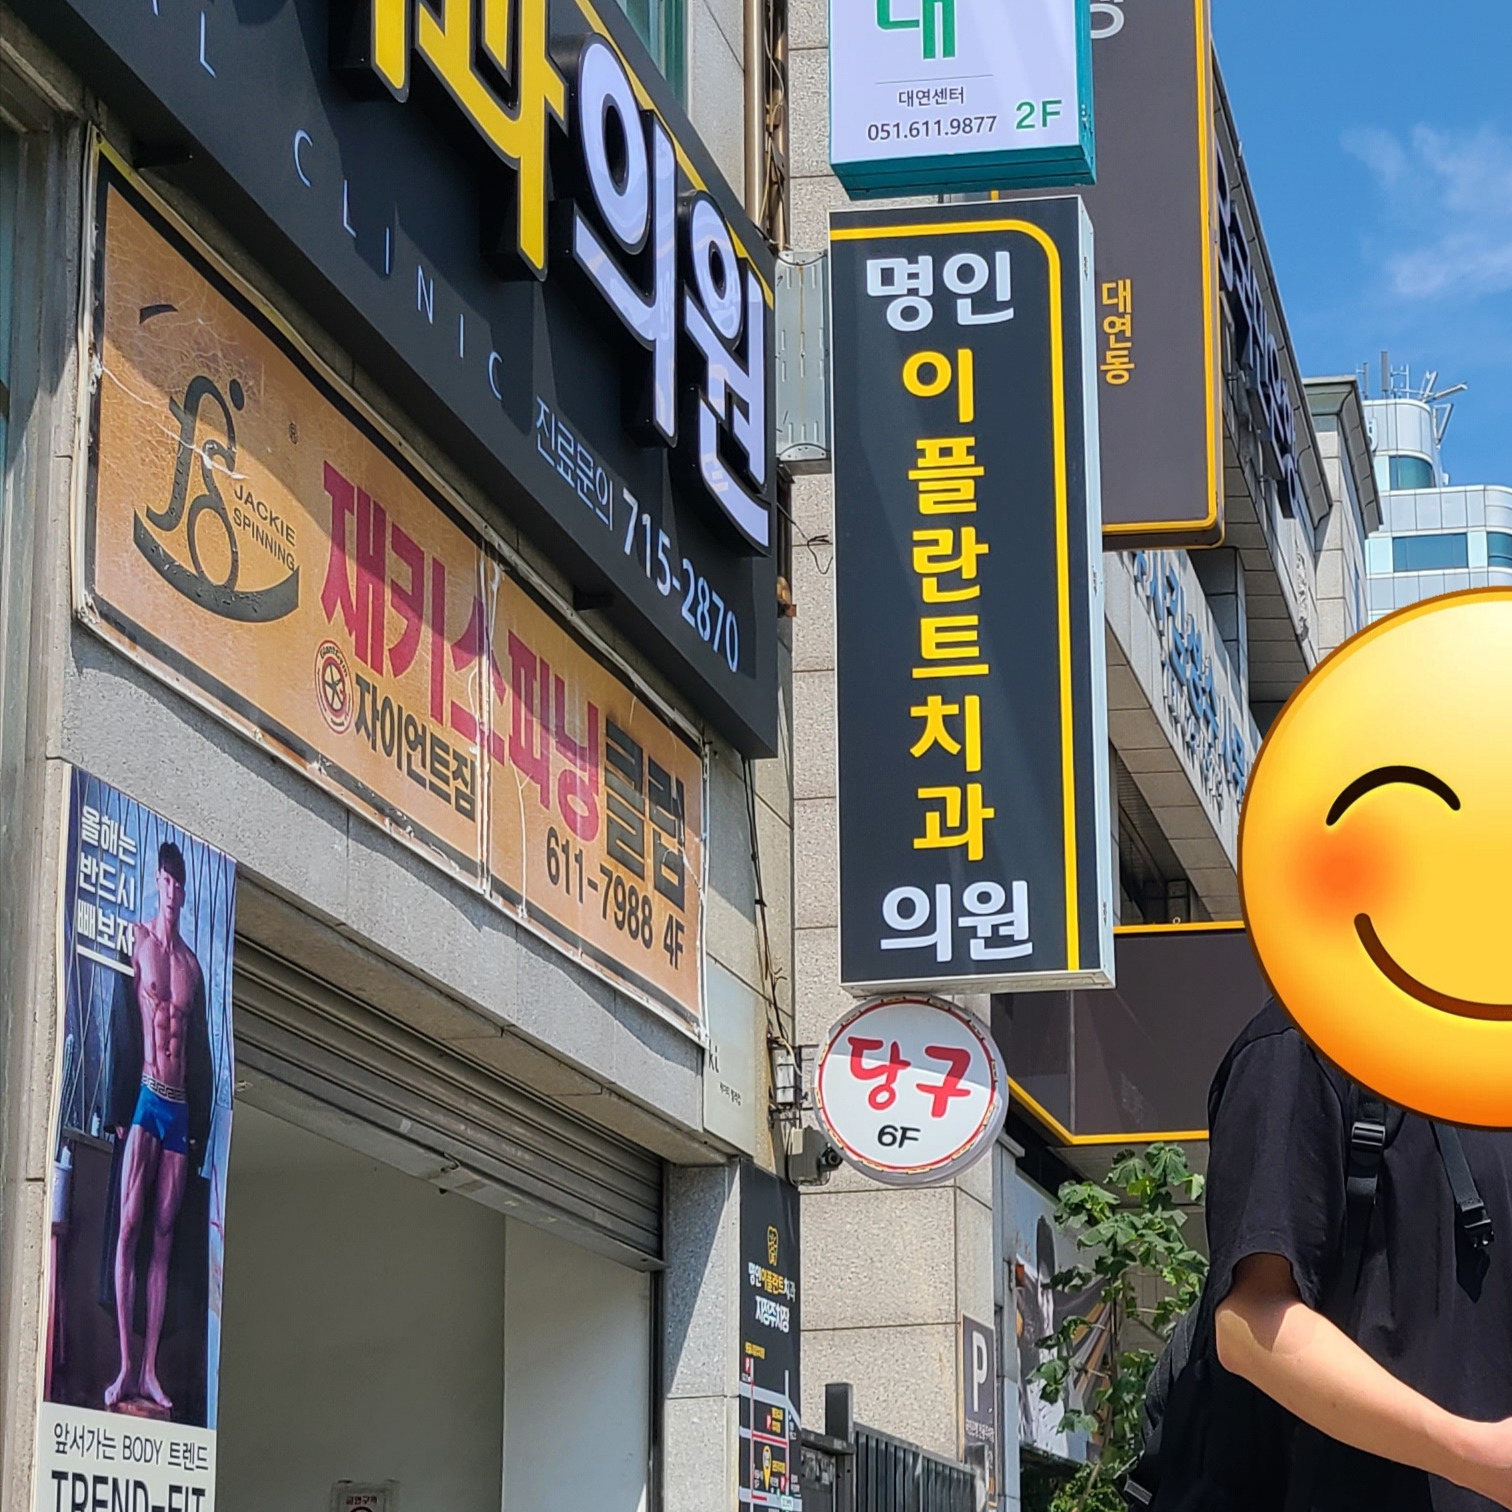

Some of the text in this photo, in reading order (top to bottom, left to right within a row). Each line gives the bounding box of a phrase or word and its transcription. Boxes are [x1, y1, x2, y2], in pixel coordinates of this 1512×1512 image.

[866, 115, 998, 142] 051.611.9877
[898, 85, 965, 107] 대연센터
[1015, 100, 1062, 130] 2F
[293, 128, 504, 400] CLINIC
[866, 251, 1014, 332] 명인
[1101, 279, 1136, 386] 대연동
[232, 506, 297, 573] SPINNING
[234, 484, 297, 548] JACKIE
[535, 395, 738, 673] 진료문의 715-2870
[354, 672, 478, 822] 자이언트짐
[81, 805, 137, 866] 올해는
[78, 851, 136, 913] 반드시
[546, 826, 654, 950] 611-7988
[76, 906, 136, 957] 빼보자
[880, 879, 1033, 963] 의원
[847, 1036, 972, 1118] 당구
[876, 1122, 921, 1149] 6F
[972, 1330, 989, 1412] P
[53, 1422, 209, 1472] 앞서가는 BODY 트렌드
